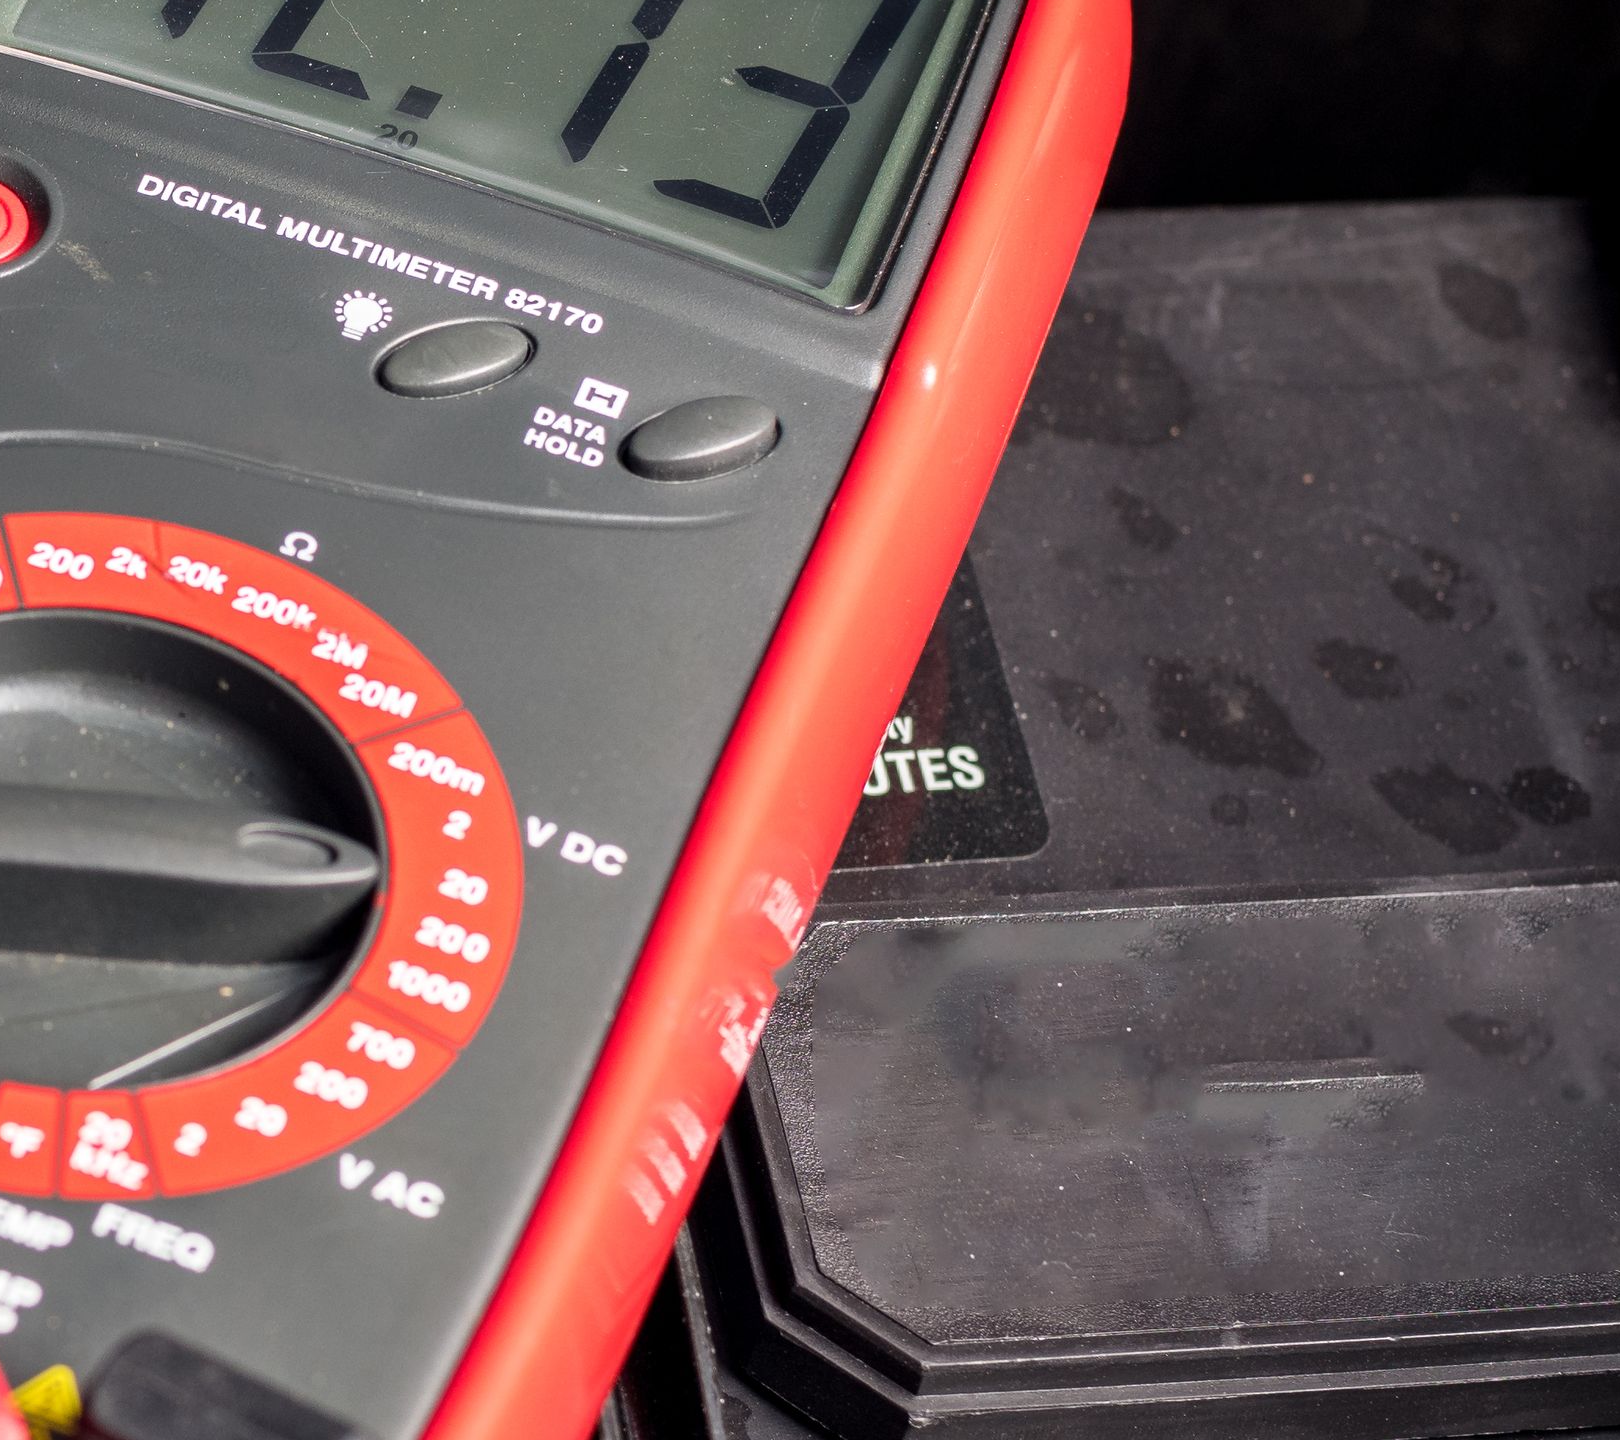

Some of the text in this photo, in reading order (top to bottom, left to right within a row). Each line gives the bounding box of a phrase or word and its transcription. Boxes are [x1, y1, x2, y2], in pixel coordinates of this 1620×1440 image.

[374, 122, 419, 152] 20
[137, 173, 604, 335] DIGITAL MULTIMETER 82170
[533, 405, 606, 447] DATA
[524, 427, 605, 469] HOLD
[26, 541, 95, 581] 200
[105, 546, 148, 580] 2k
[168, 555, 229, 596] 20k
[231, 585, 317, 631] 200k
[311, 627, 369, 670] 2M
[338, 673, 418, 719] 20M
[387, 740, 486, 796] 200m
[442, 809, 473, 840] 2
[526, 815, 628, 876] V DC
[437, 867, 488, 906] 20
[414, 915, 491, 964] 200
[387, 960, 472, 1013] 1000
[346, 1020, 416, 1071] 700
[292, 1059, 369, 1110] 200
[233, 1095, 288, 1138] 20
[173, 1121, 208, 1157] 2
[338, 1152, 446, 1219] V AC
